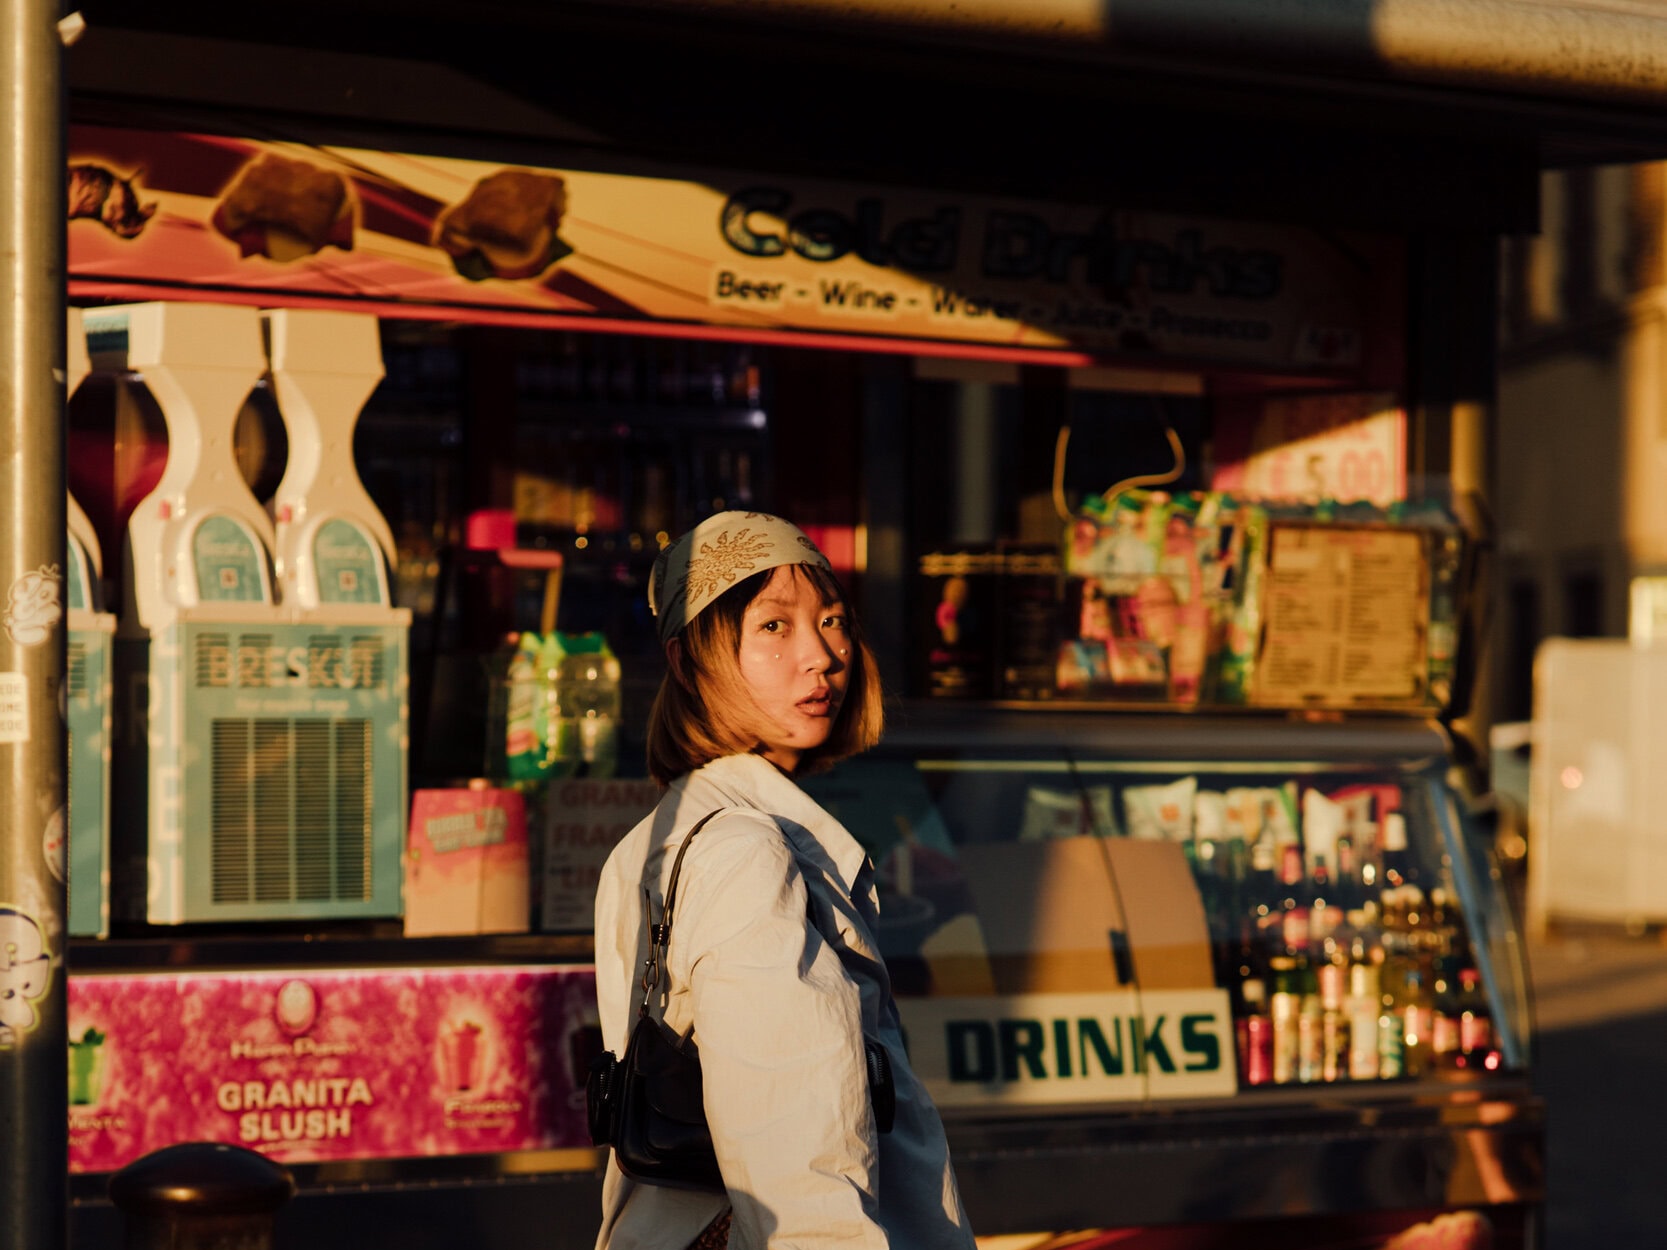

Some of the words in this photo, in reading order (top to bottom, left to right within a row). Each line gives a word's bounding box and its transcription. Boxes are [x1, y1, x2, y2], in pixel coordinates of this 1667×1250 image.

[721, 186, 960, 271] Cold
[983, 208, 1285, 300] Drinks
[716, 270, 784, 300] Beer
[819, 279, 897, 309] Wine
[930, 286, 1021, 319] Water
[1053, 300, 1124, 330] Juice
[1150, 305, 1272, 342] Prosecco
[944, 1014, 1221, 1083] DRINKS
[216, 1076, 375, 1113] GRANITA
[238, 1107, 353, 1143] SLUSH
